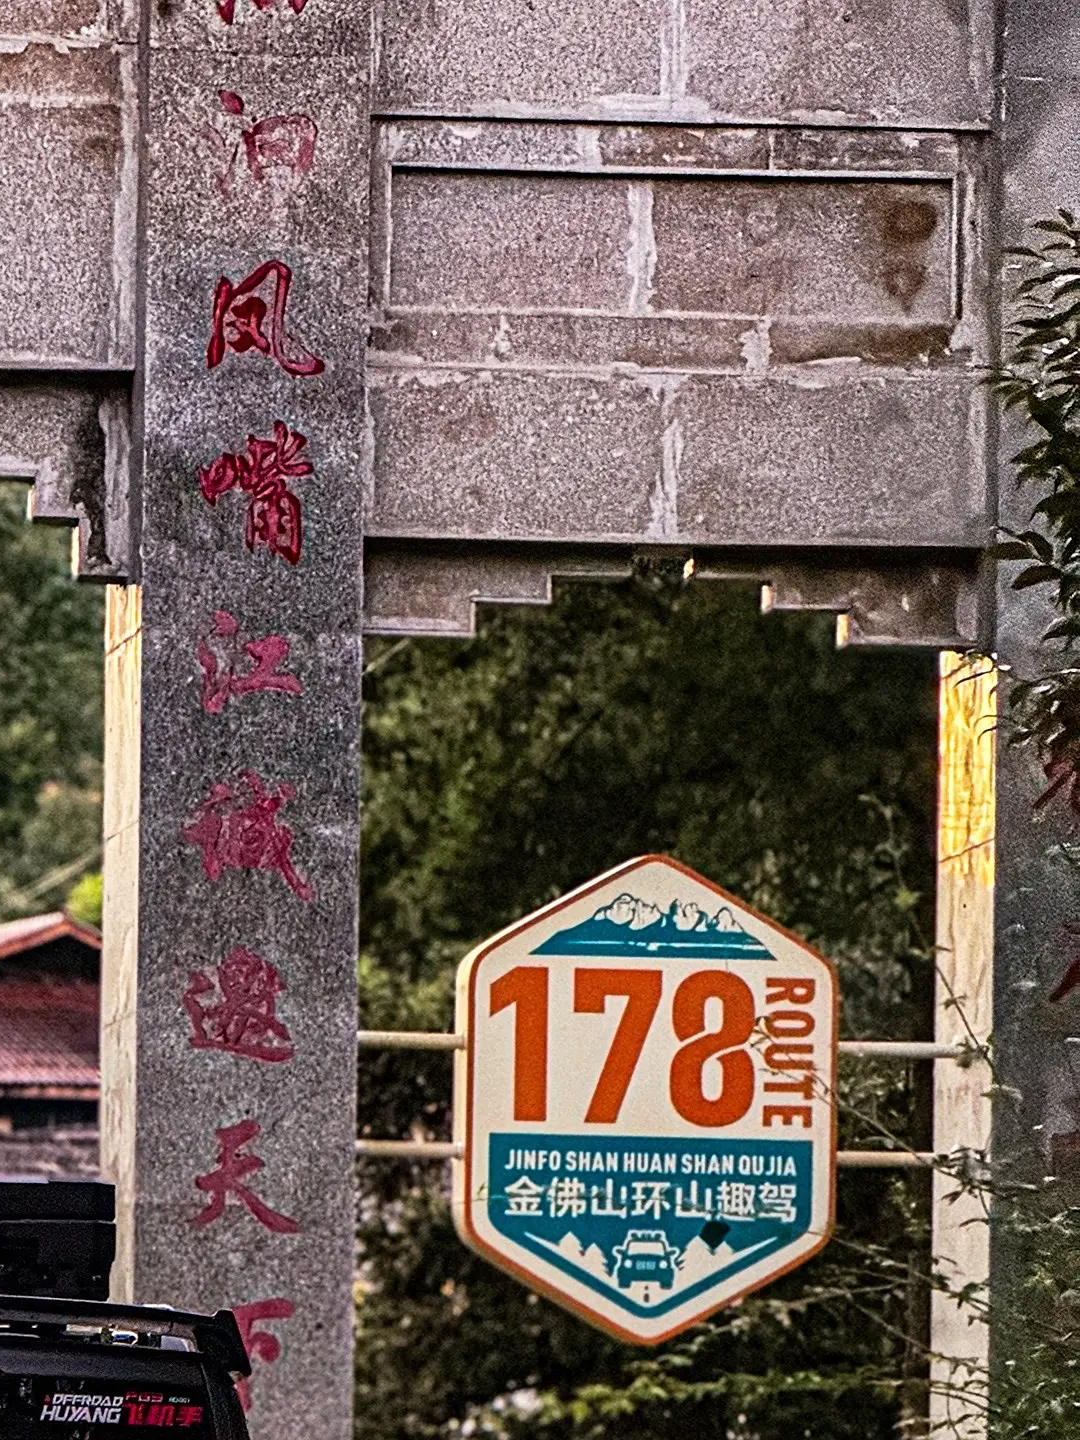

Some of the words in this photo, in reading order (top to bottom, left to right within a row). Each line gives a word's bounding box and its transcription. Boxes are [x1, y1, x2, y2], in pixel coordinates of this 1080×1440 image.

[489, 966, 756, 1128] 178
[762, 977, 816, 1129] ROUTE
[504, 1148, 561, 1171] JINFO
[566, 1150, 618, 1172] SHAN
[623, 1152, 677, 1174] HUAN
[681, 1153, 735, 1175] SHAN
[504, 1175, 798, 1223] 金佛山环山趣驾
[39, 1405, 122, 1424] HUYANG
